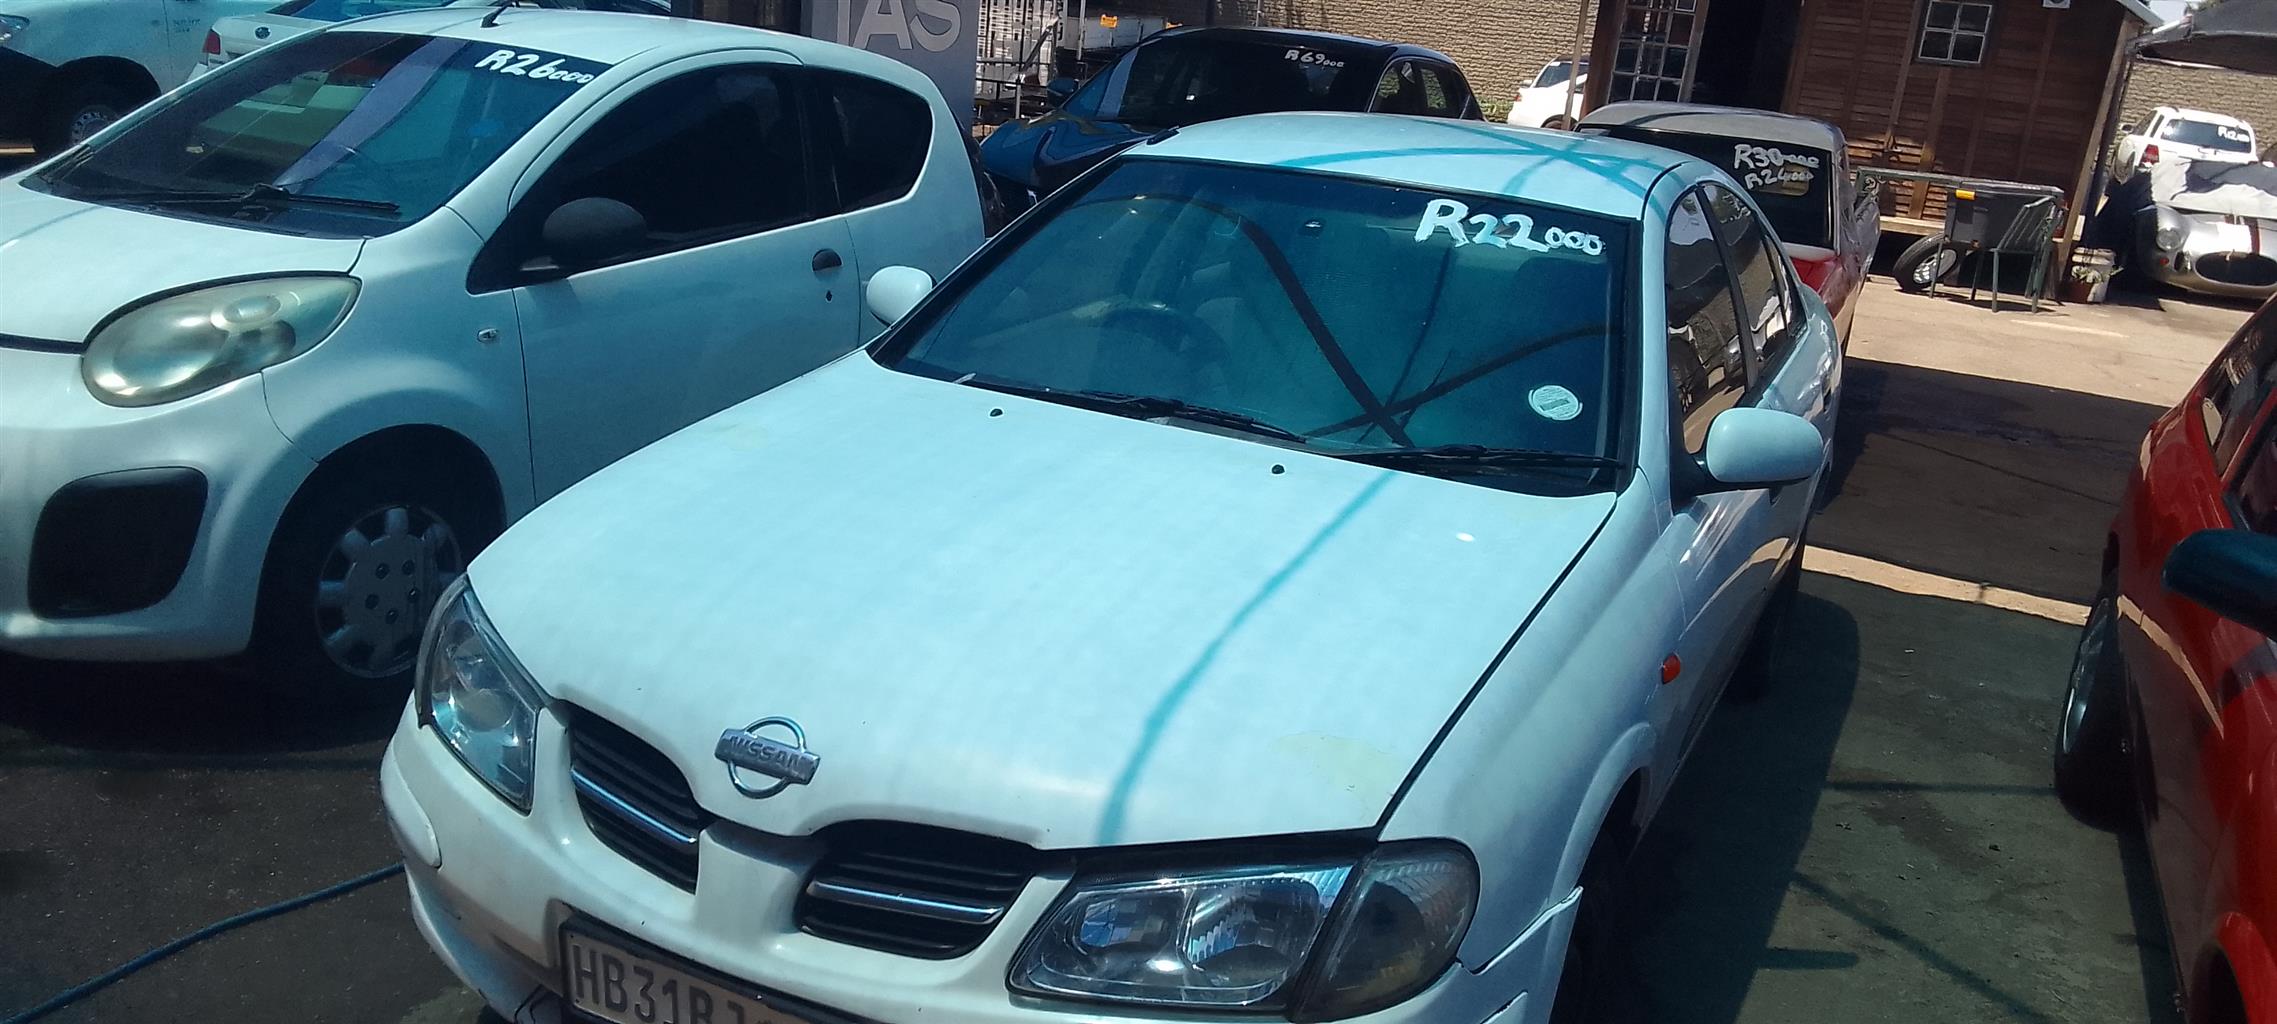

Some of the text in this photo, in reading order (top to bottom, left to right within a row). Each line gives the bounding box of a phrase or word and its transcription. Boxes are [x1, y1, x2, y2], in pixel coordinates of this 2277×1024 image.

[474, 49, 594, 84] R26000
[1414, 199, 1604, 256] R22000
[729, 735, 803, 770] NISSAN
